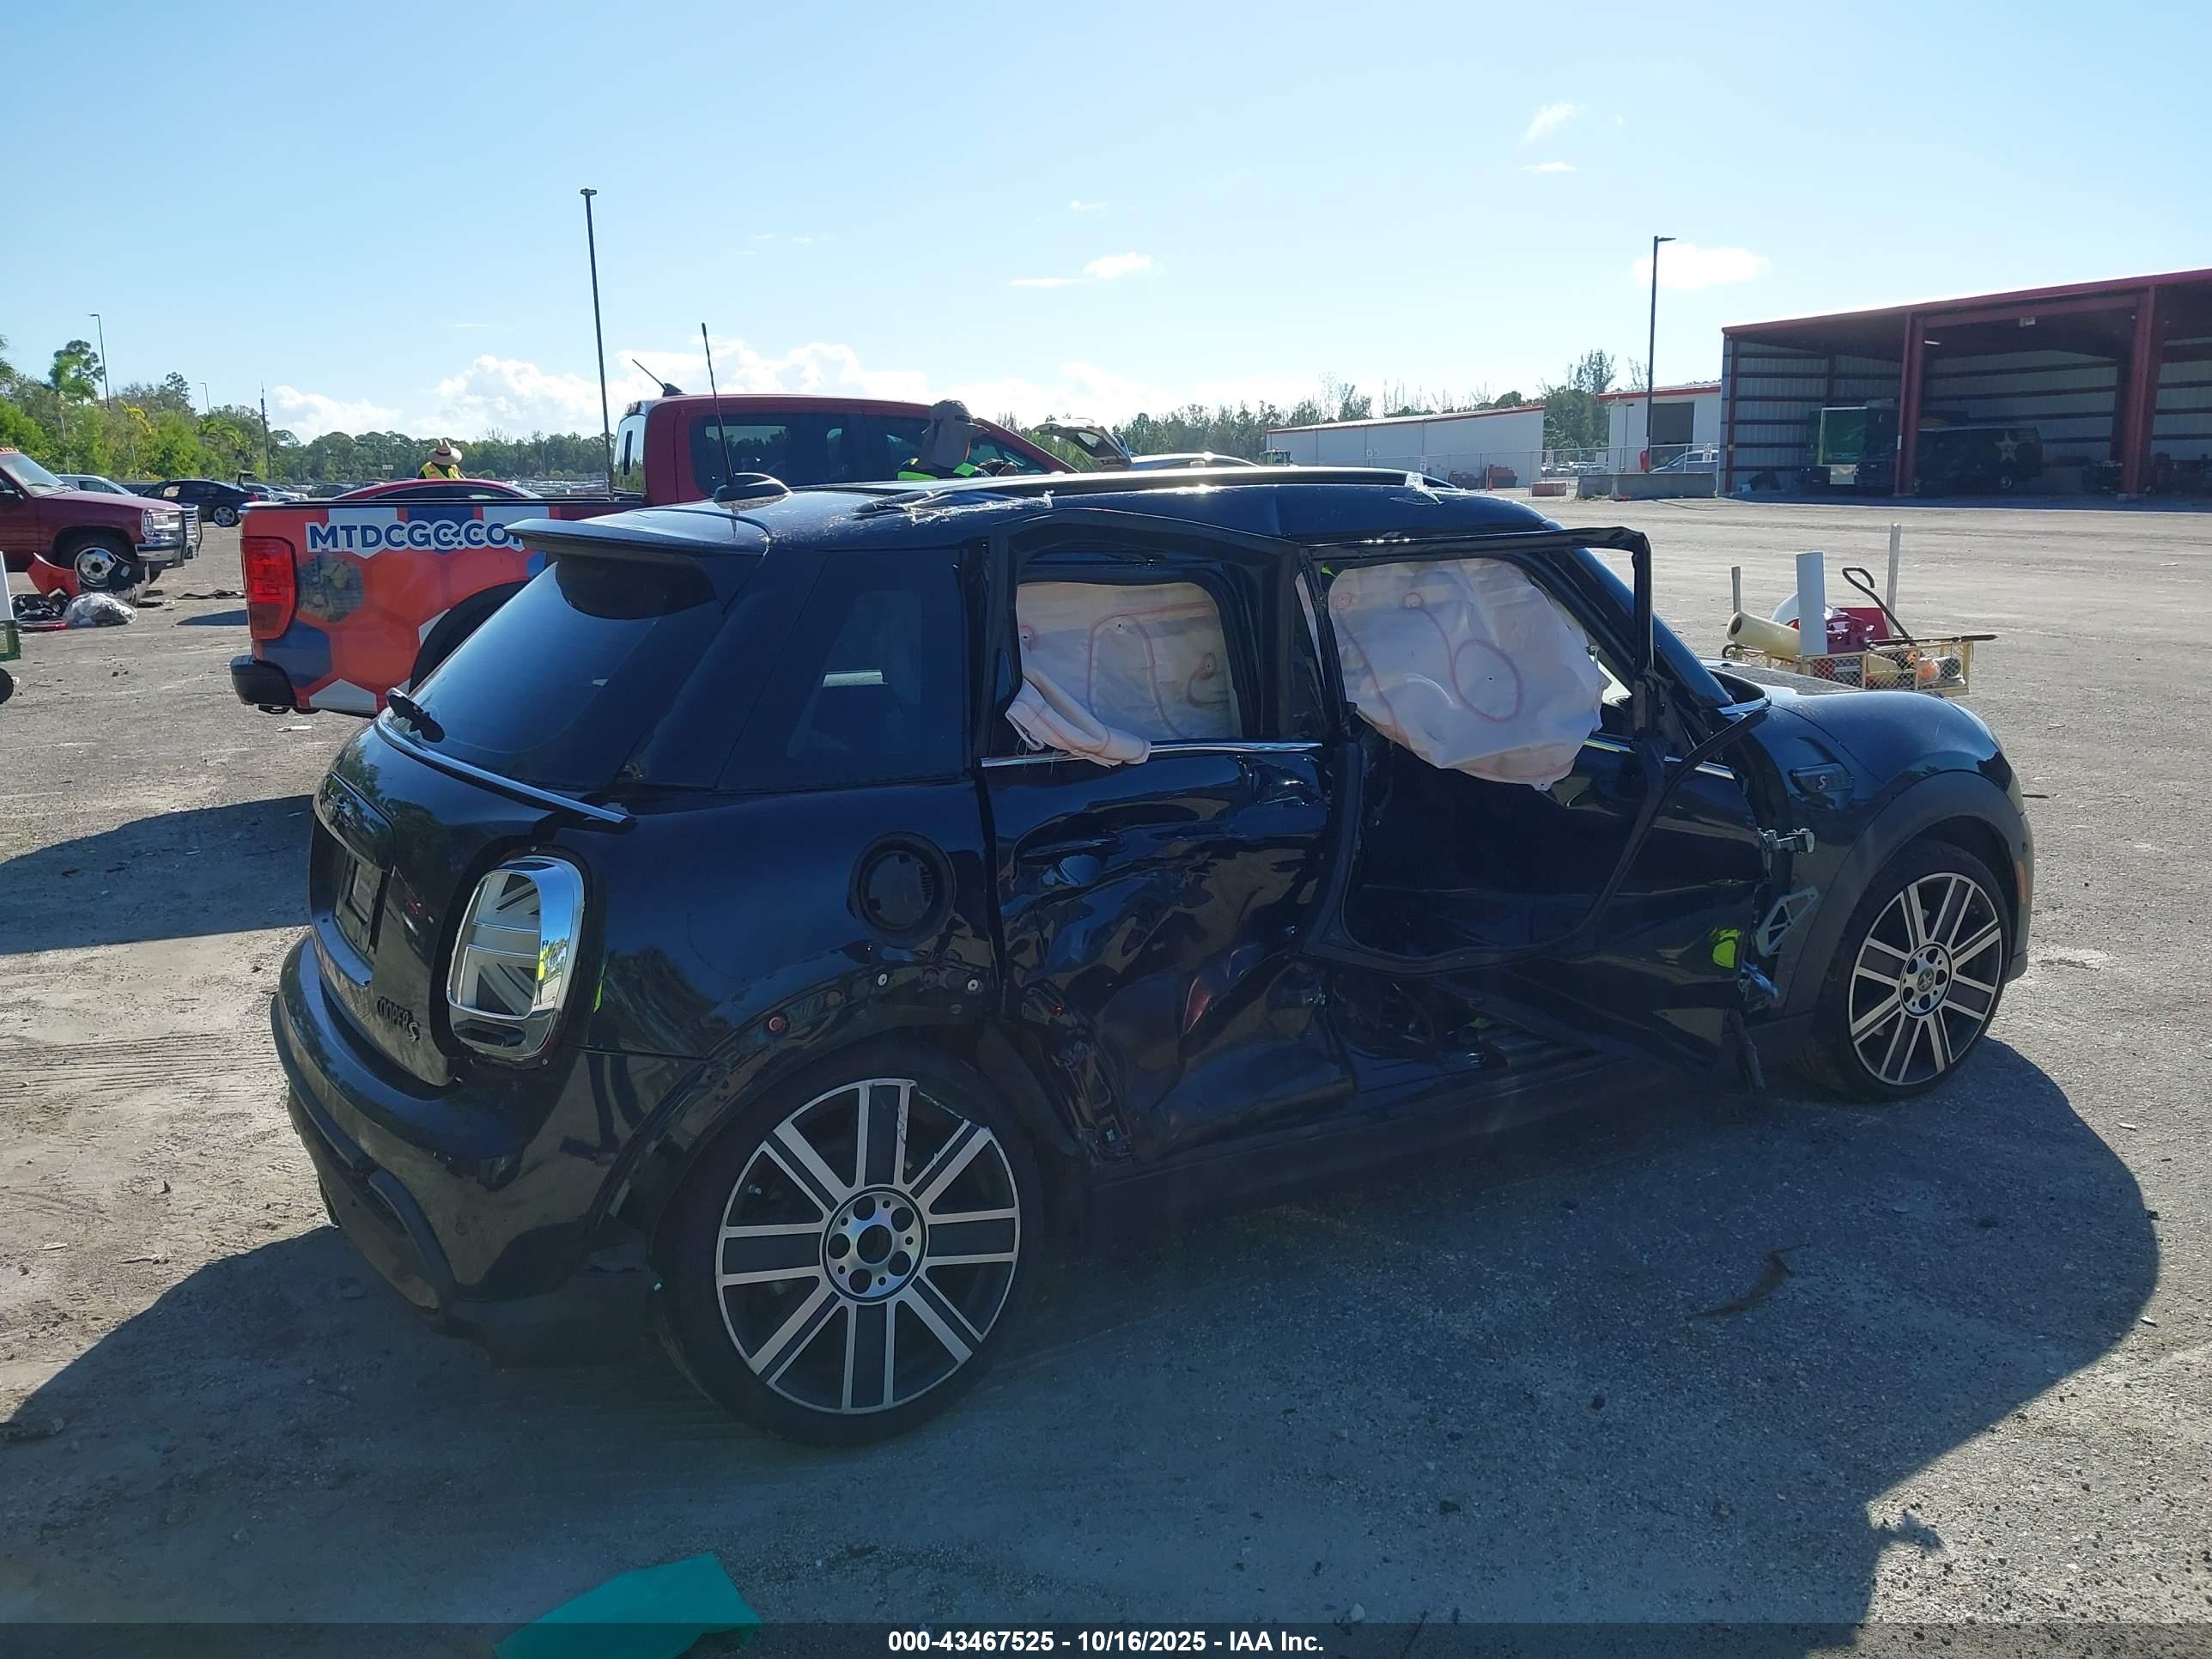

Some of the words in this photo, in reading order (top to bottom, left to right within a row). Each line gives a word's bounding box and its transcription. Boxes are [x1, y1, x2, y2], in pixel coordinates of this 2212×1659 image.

[308, 522, 521, 550] MTDCGC.CO
[1818, 775, 1827, 790] S
[408, 1021, 420, 1043] S
